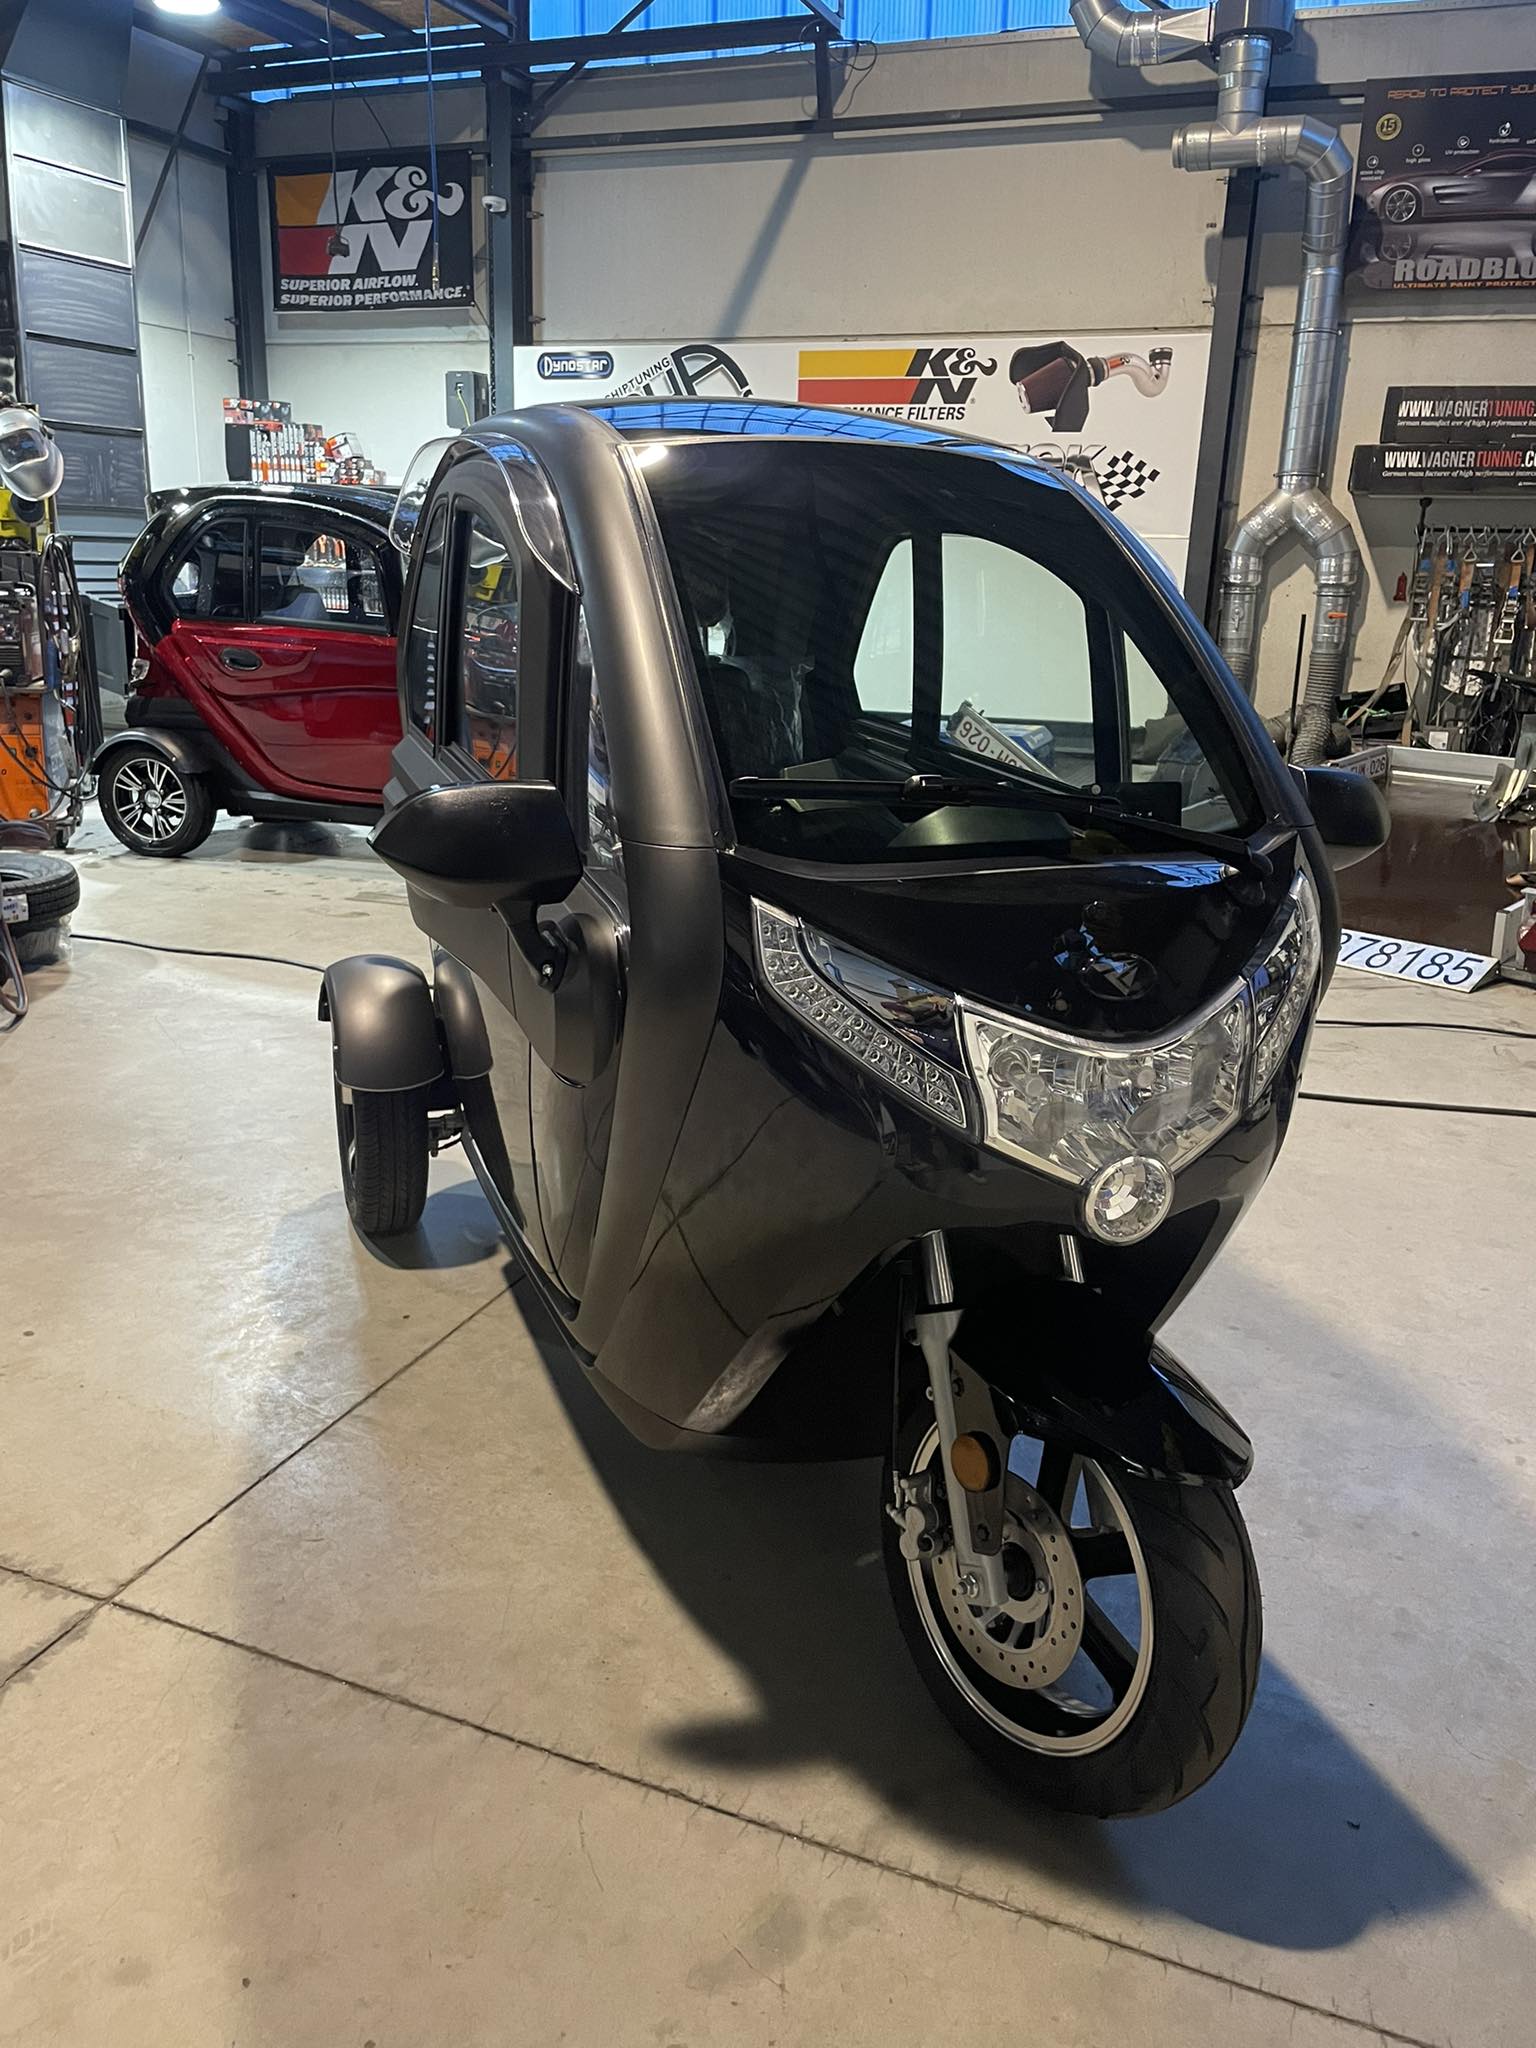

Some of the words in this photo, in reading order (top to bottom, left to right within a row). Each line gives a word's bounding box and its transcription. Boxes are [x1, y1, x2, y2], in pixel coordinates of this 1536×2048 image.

[280, 278, 351, 291] SUPERIOR
[352, 274, 419, 290] AIRFLOW.
[280, 293, 353, 306] SUPERIOR
[354, 285, 467, 305] PERFORMANCE.
[907, 406, 966, 421] FILTERS
[1384, 450, 1536, 469] WWW.WAGNERTUNING.C
